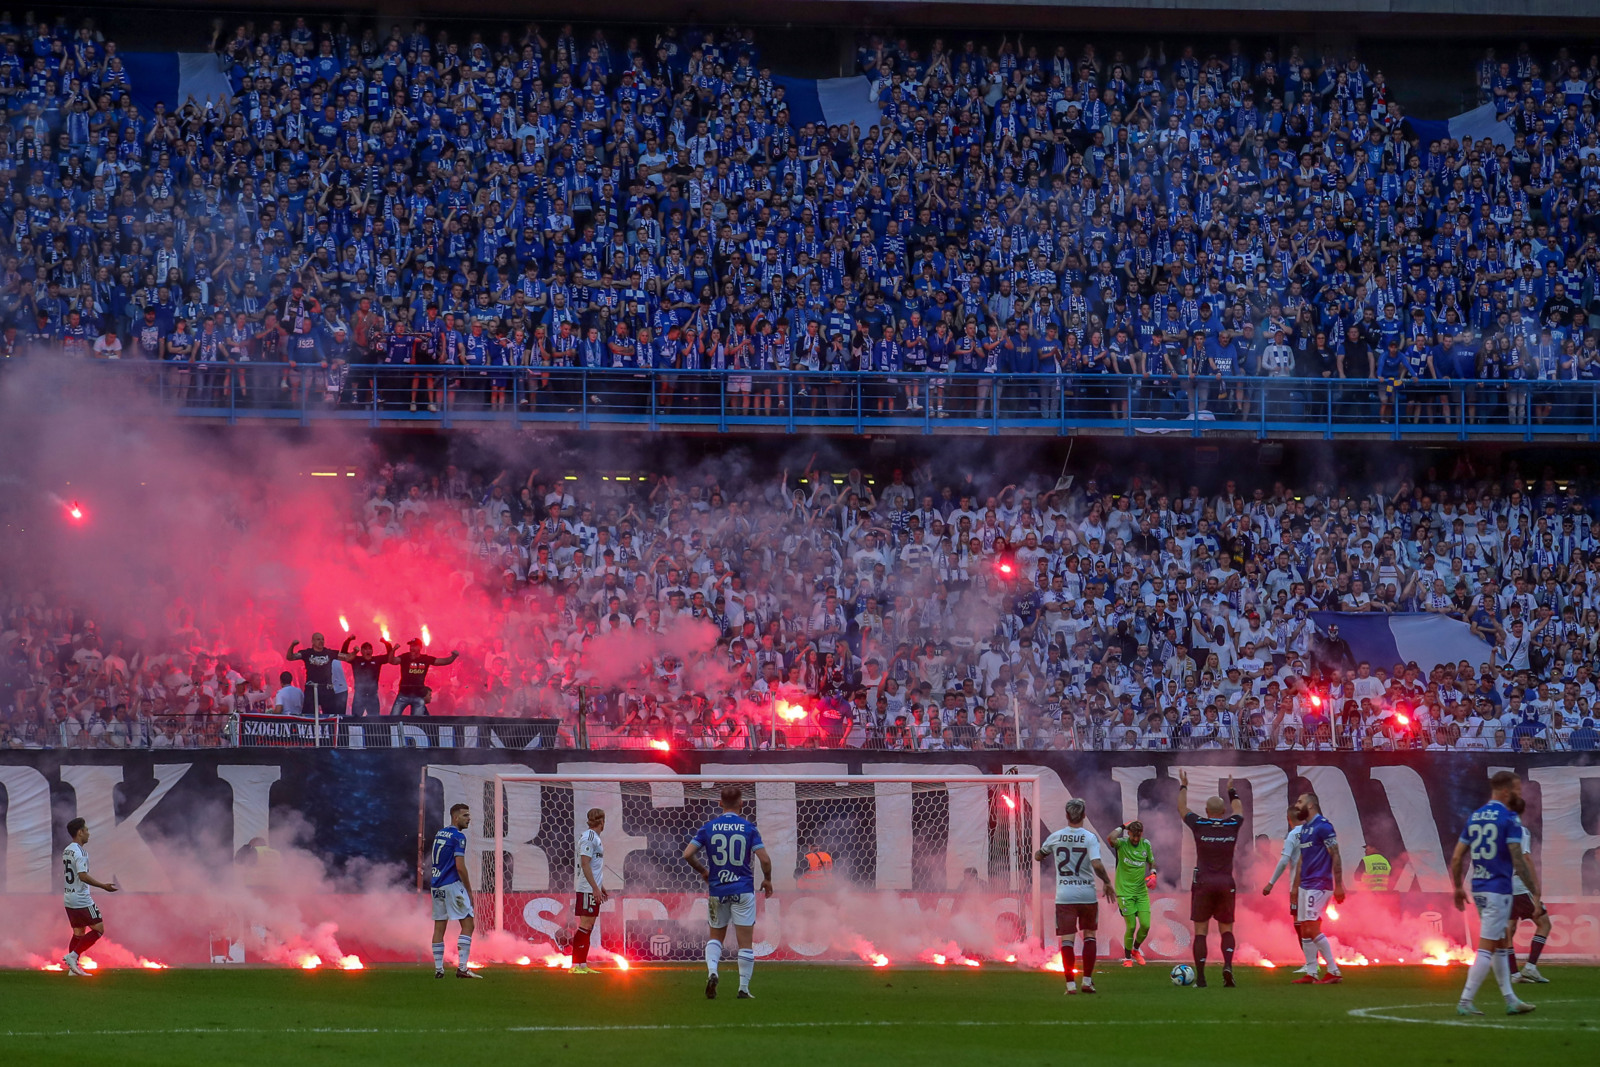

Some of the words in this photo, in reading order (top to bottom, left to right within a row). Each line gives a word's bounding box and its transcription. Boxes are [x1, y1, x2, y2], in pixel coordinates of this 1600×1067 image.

[244, 720, 291, 738] SZOGUN
[712, 823, 745, 832] KVEKVE
[1058, 833, 1086, 843] JOSUÉ
[431, 838, 447, 865] 17
[710, 833, 747, 867] 30
[1468, 823, 1498, 860] 23
[63, 859, 75, 884] 5
[1056, 846, 1088, 877] 27
[717, 869, 741, 884] Pils
[1307, 895, 1315, 908] 9
